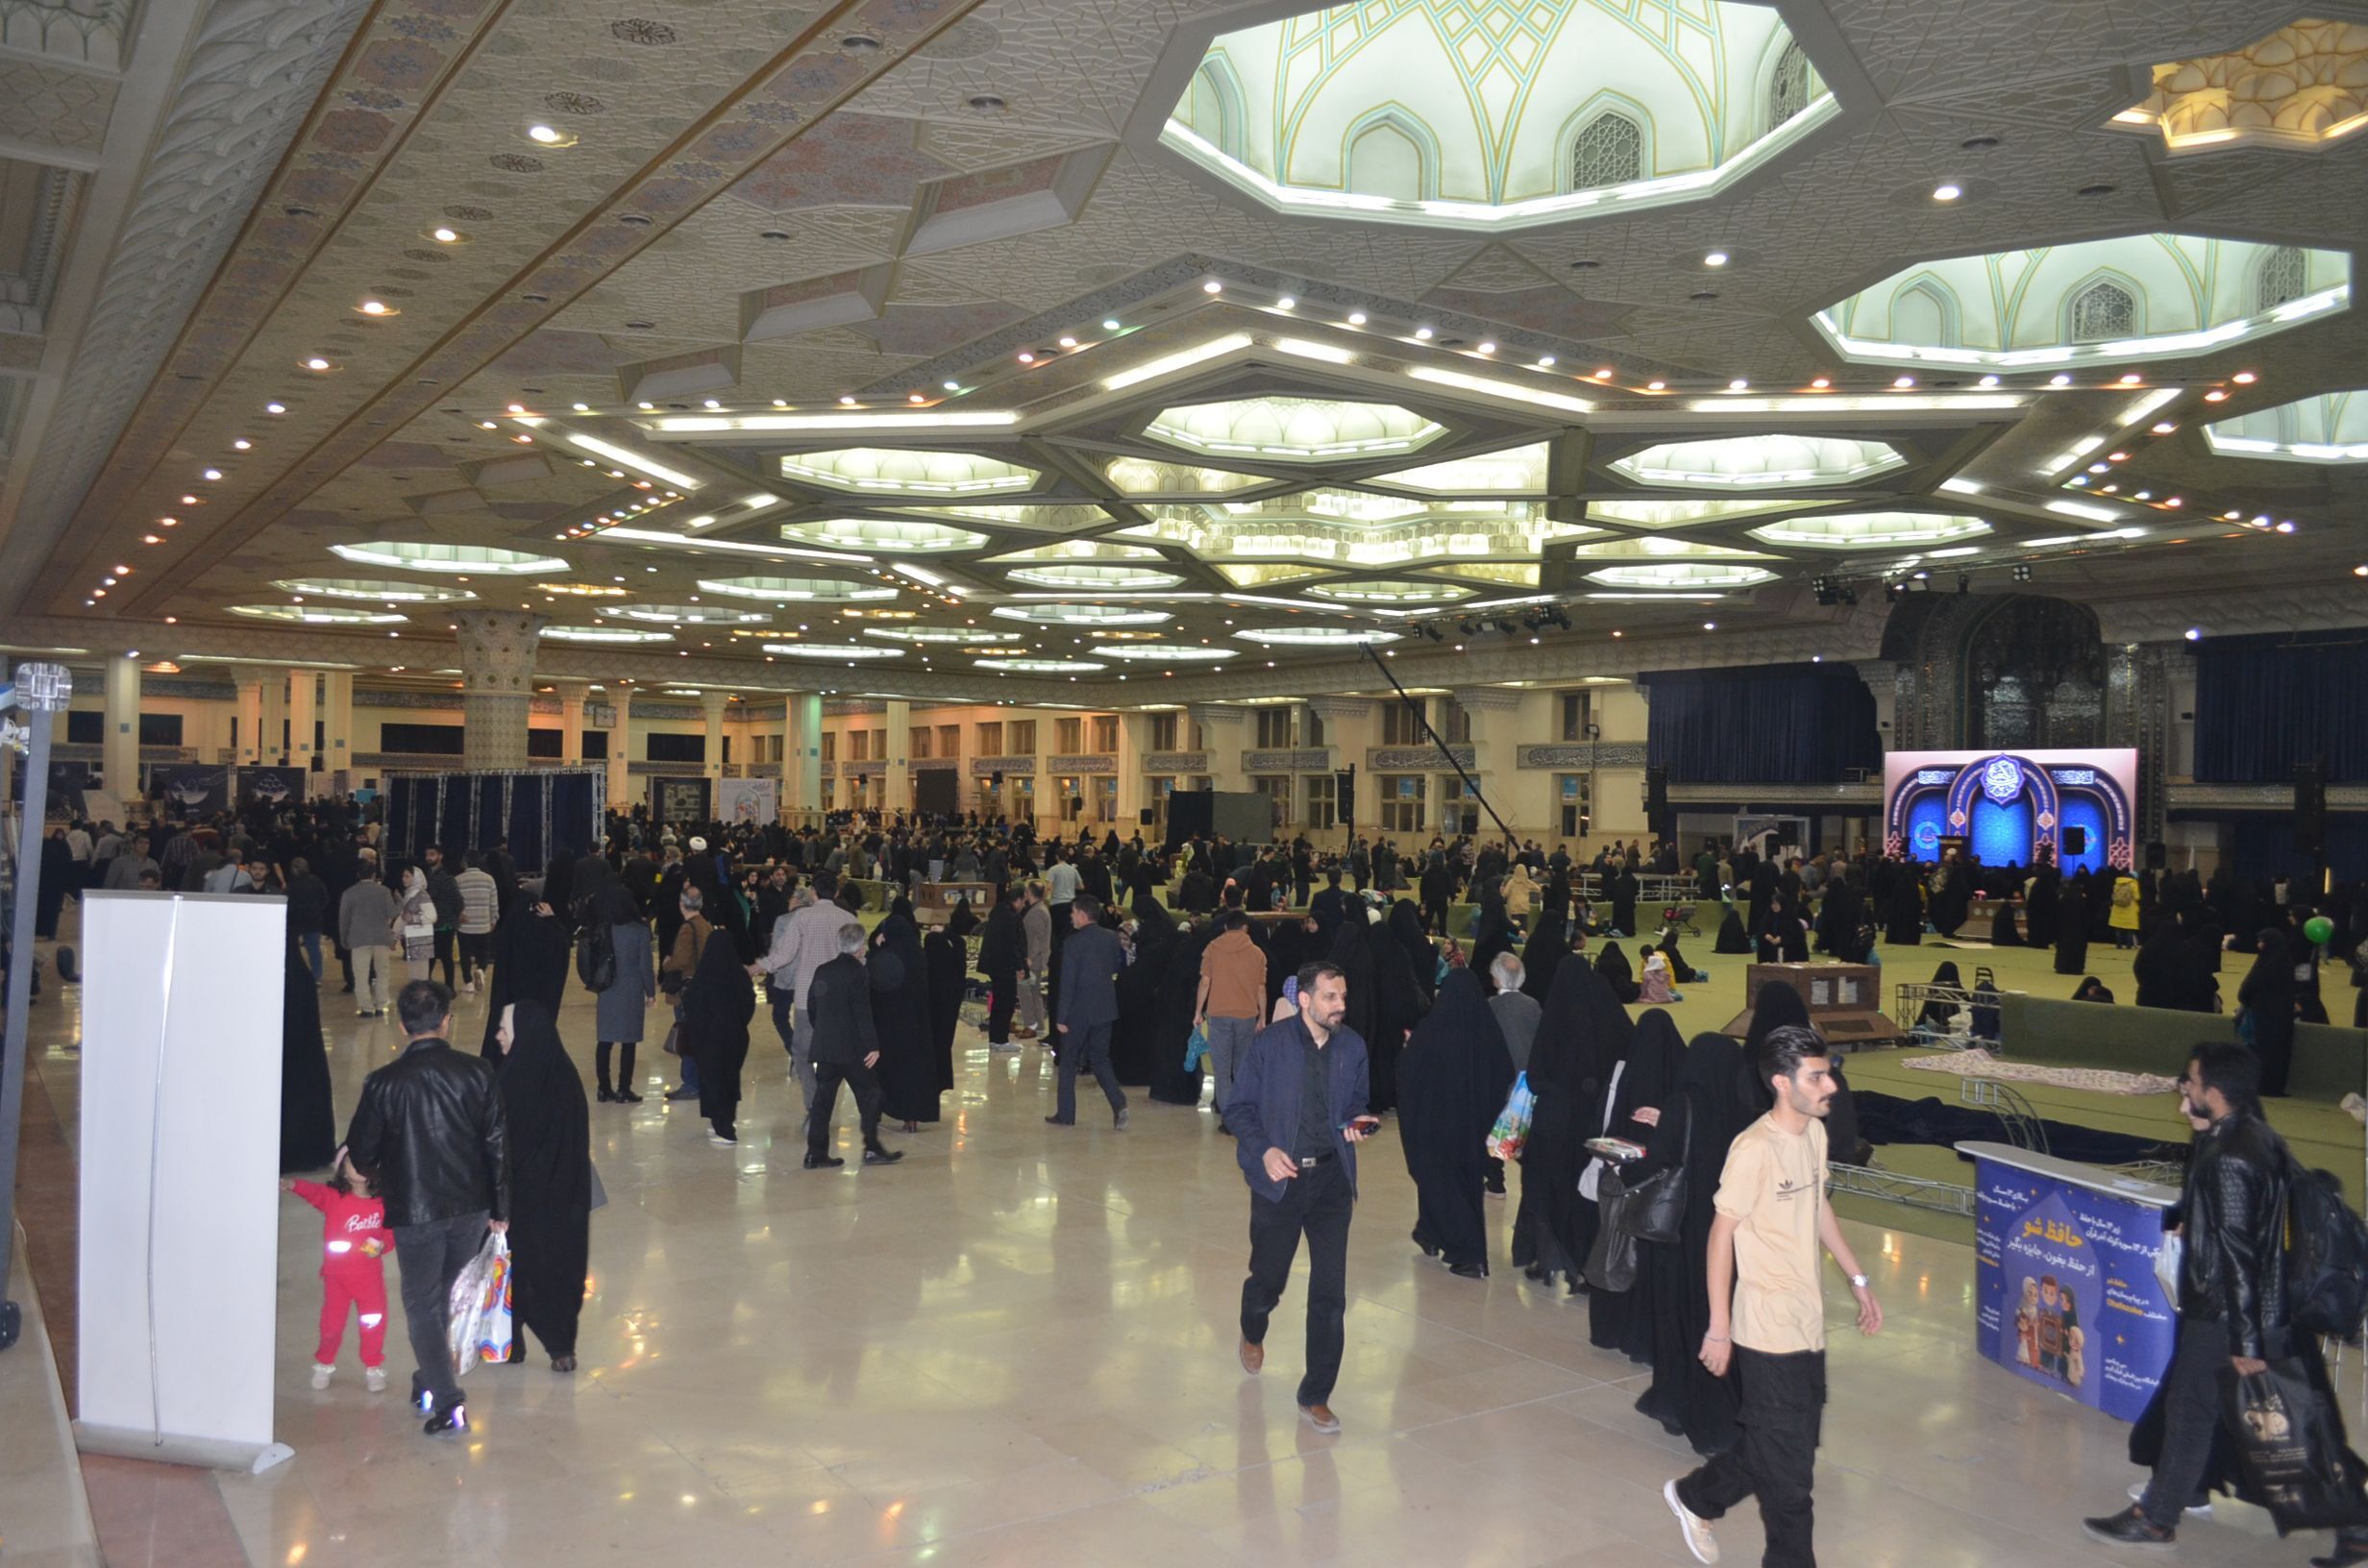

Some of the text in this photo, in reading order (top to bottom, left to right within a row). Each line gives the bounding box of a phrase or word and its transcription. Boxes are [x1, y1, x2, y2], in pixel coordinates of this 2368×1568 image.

[344, 1212, 381, 1233] Barbie
[2022, 1216, 2083, 1247] حافظ شو
[2007, 1236, 2023, 1252] بگیر
[2067, 1256, 2086, 1271] حفظ
[2084, 1263, 2095, 1277] از
